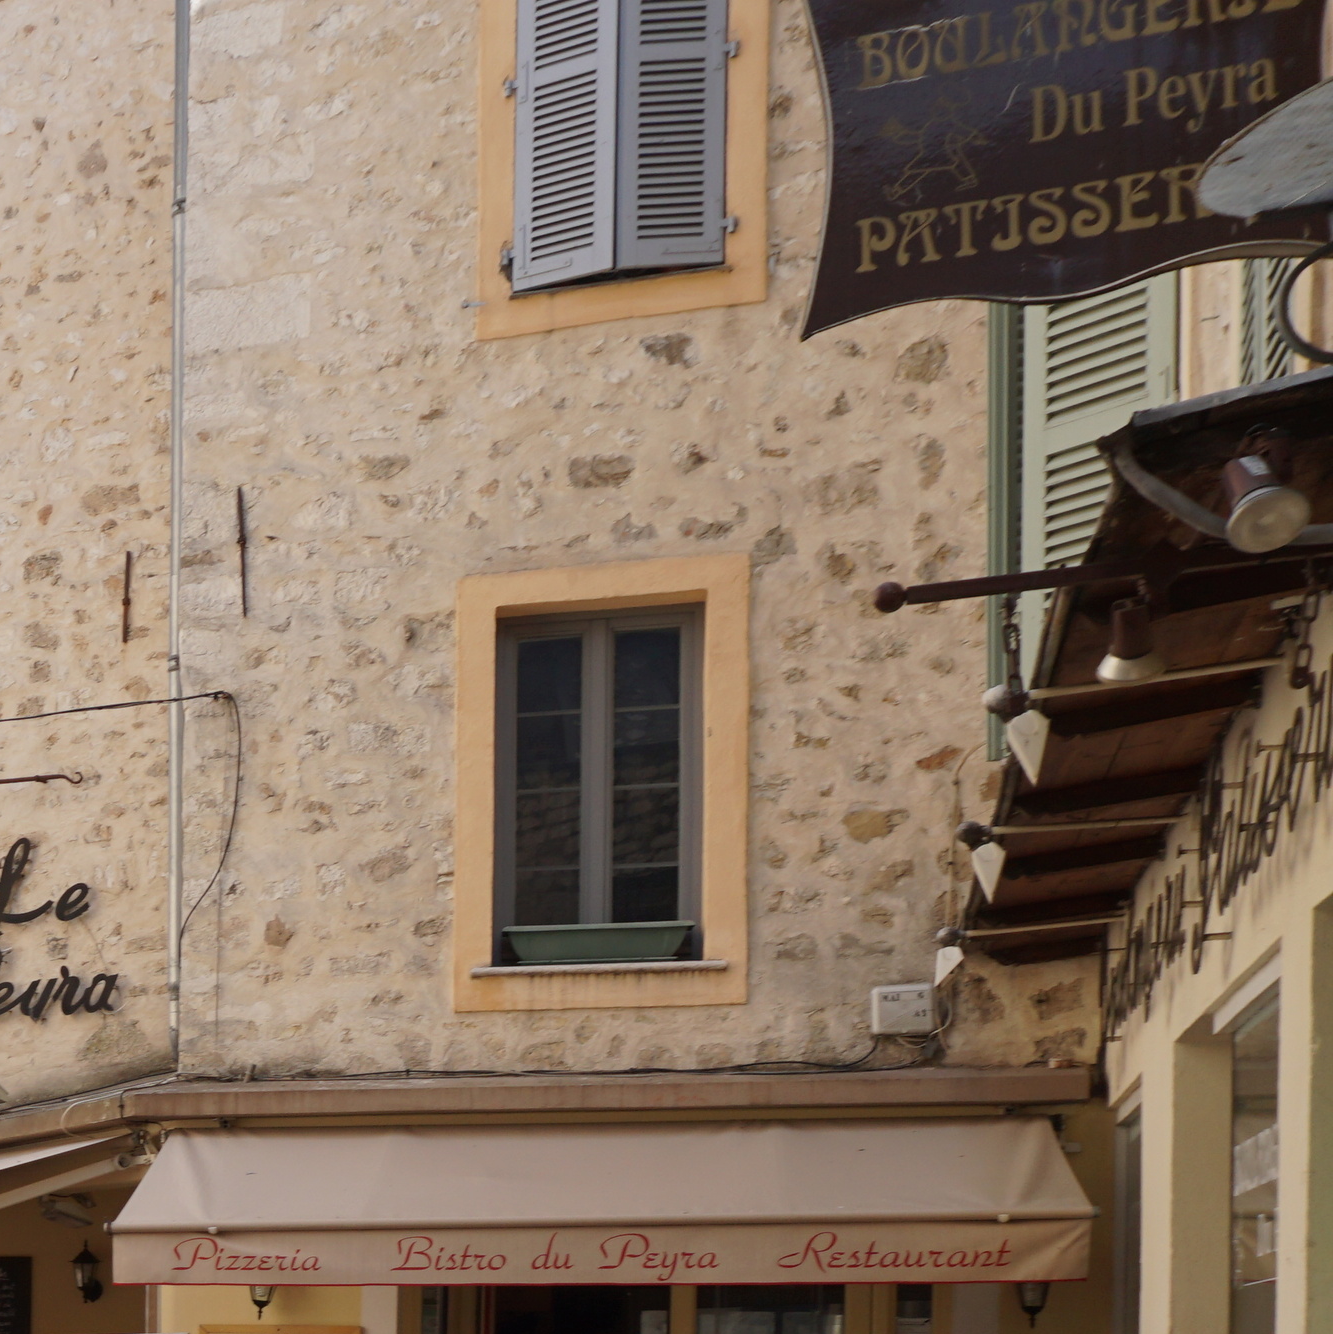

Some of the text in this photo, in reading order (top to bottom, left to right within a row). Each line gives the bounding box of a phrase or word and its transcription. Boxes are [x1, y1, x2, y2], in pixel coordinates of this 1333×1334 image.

[856, 0, 1302, 90] BOULANGER
[1029, 57, 1279, 144] Du Peyra
[855, 162, 1217, 273] PATISSER
[172, 1231, 1012, 1282] Pizzeria Bistro du Peyra Restaurant
